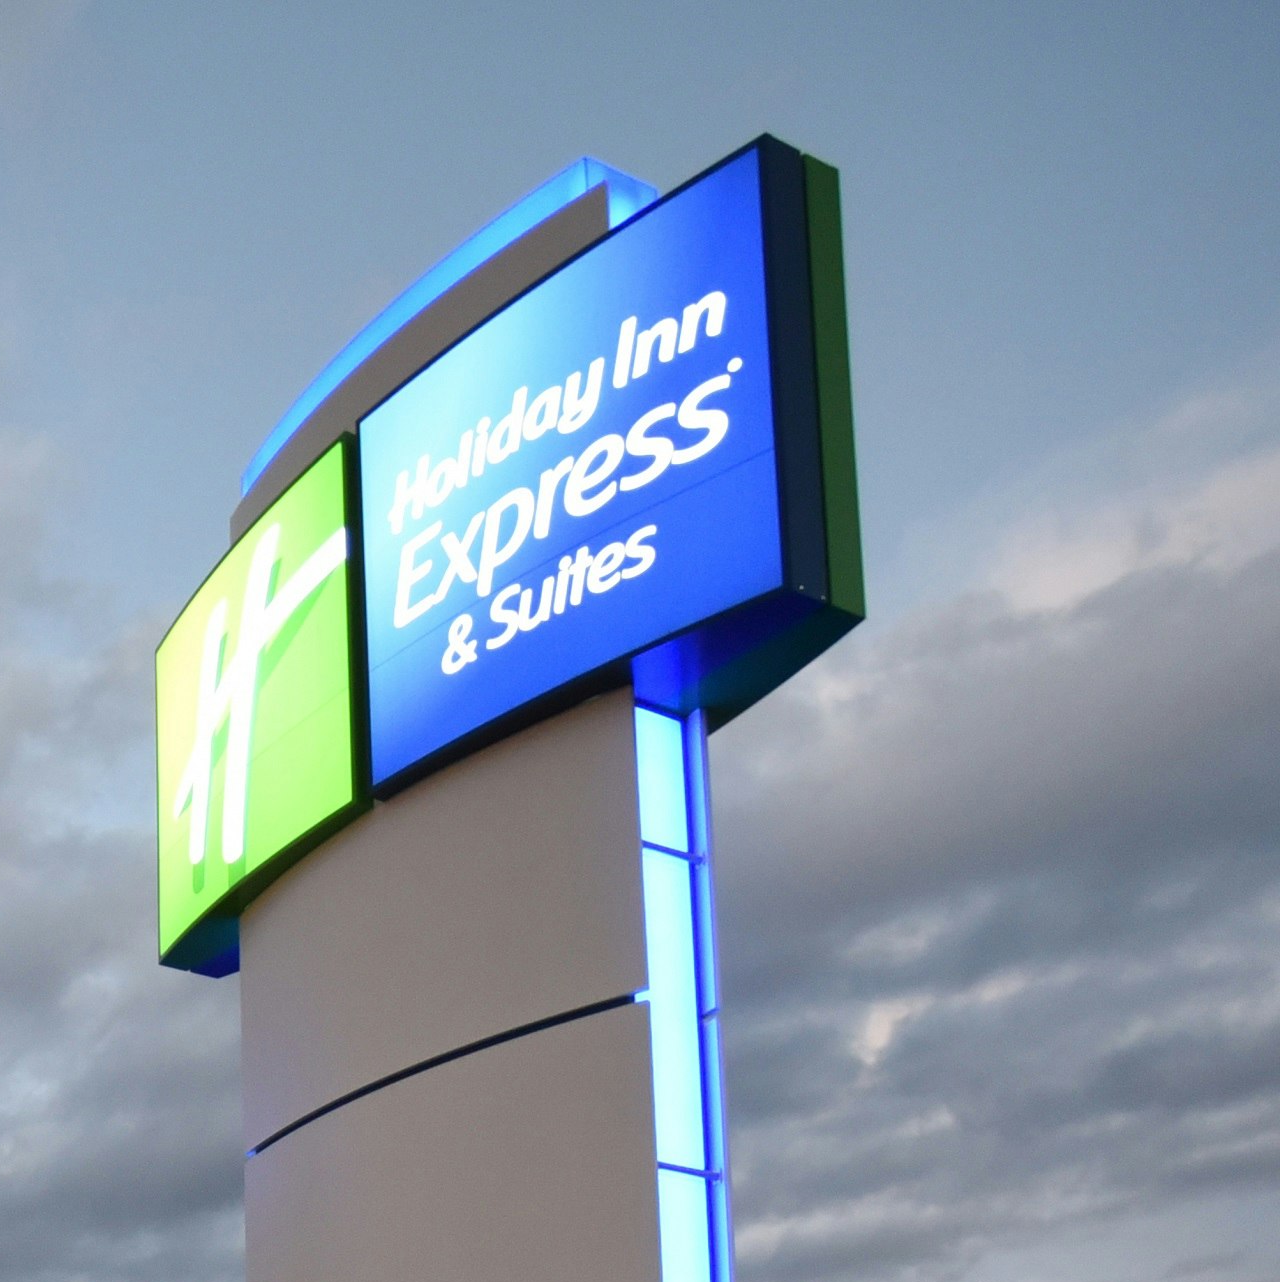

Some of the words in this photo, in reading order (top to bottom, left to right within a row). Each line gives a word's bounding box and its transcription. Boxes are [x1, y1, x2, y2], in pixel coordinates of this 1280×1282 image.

[388, 357, 605, 535] Holiday
[612, 290, 728, 389] Inn
[393, 373, 732, 629] Express
[441, 613, 479, 675] &
[486, 523, 658, 651] Suites
